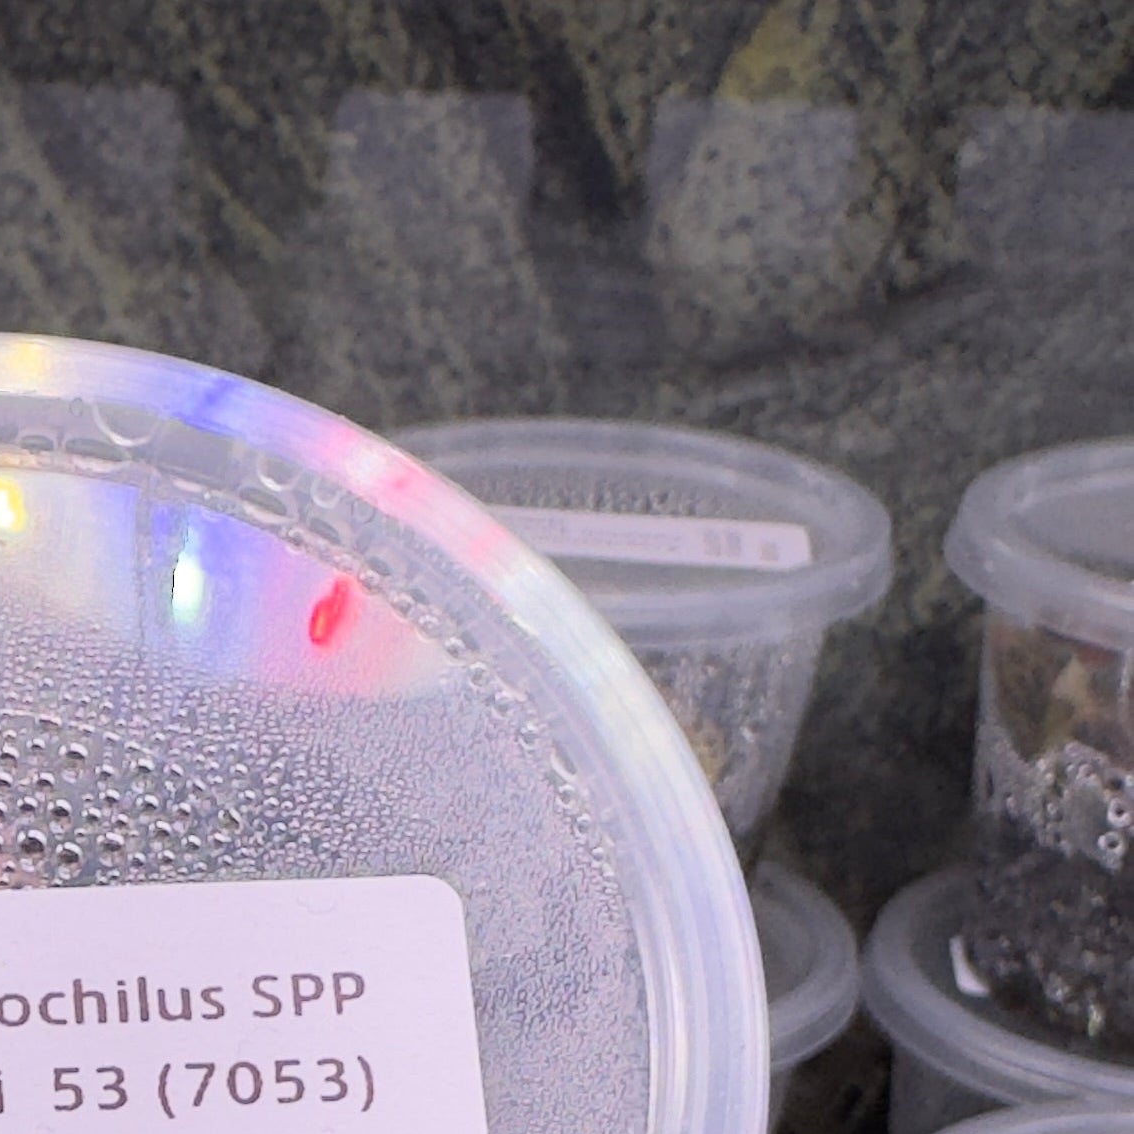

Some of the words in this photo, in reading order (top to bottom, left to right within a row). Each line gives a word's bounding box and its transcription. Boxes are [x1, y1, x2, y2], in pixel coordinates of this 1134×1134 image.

[251, 970, 367, 1019] SPP
[53, 1065, 129, 1113] 53
[157, 1055, 376, 1120] (7053)
